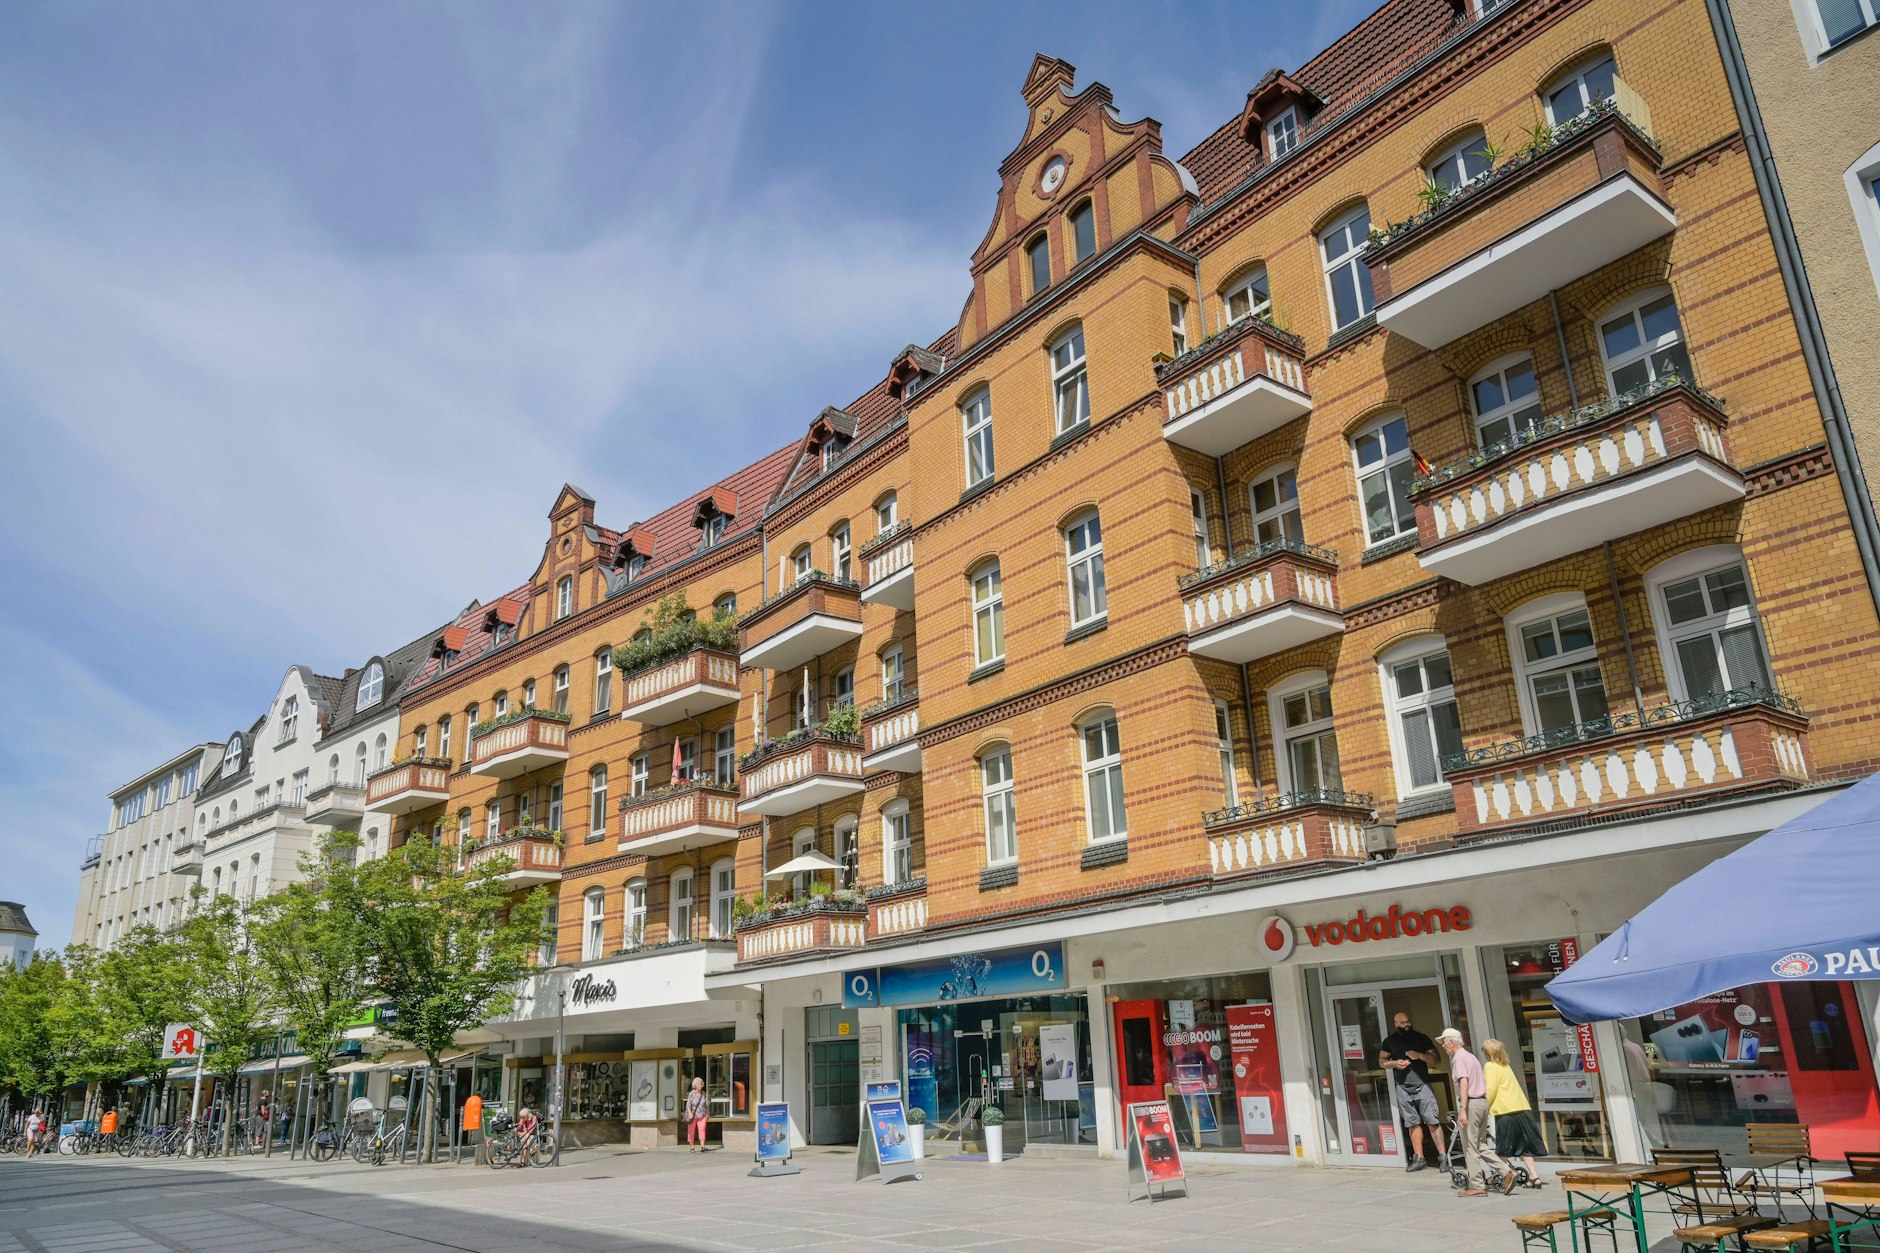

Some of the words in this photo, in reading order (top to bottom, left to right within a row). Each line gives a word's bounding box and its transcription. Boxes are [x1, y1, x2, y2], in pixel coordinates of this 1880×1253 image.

[1304, 904, 1471, 947] vodafone
[1549, 943, 1561, 964] FÜR
[1564, 942, 1576, 968] NEN
[1578, 1023, 1596, 1069] GESCHÄ
